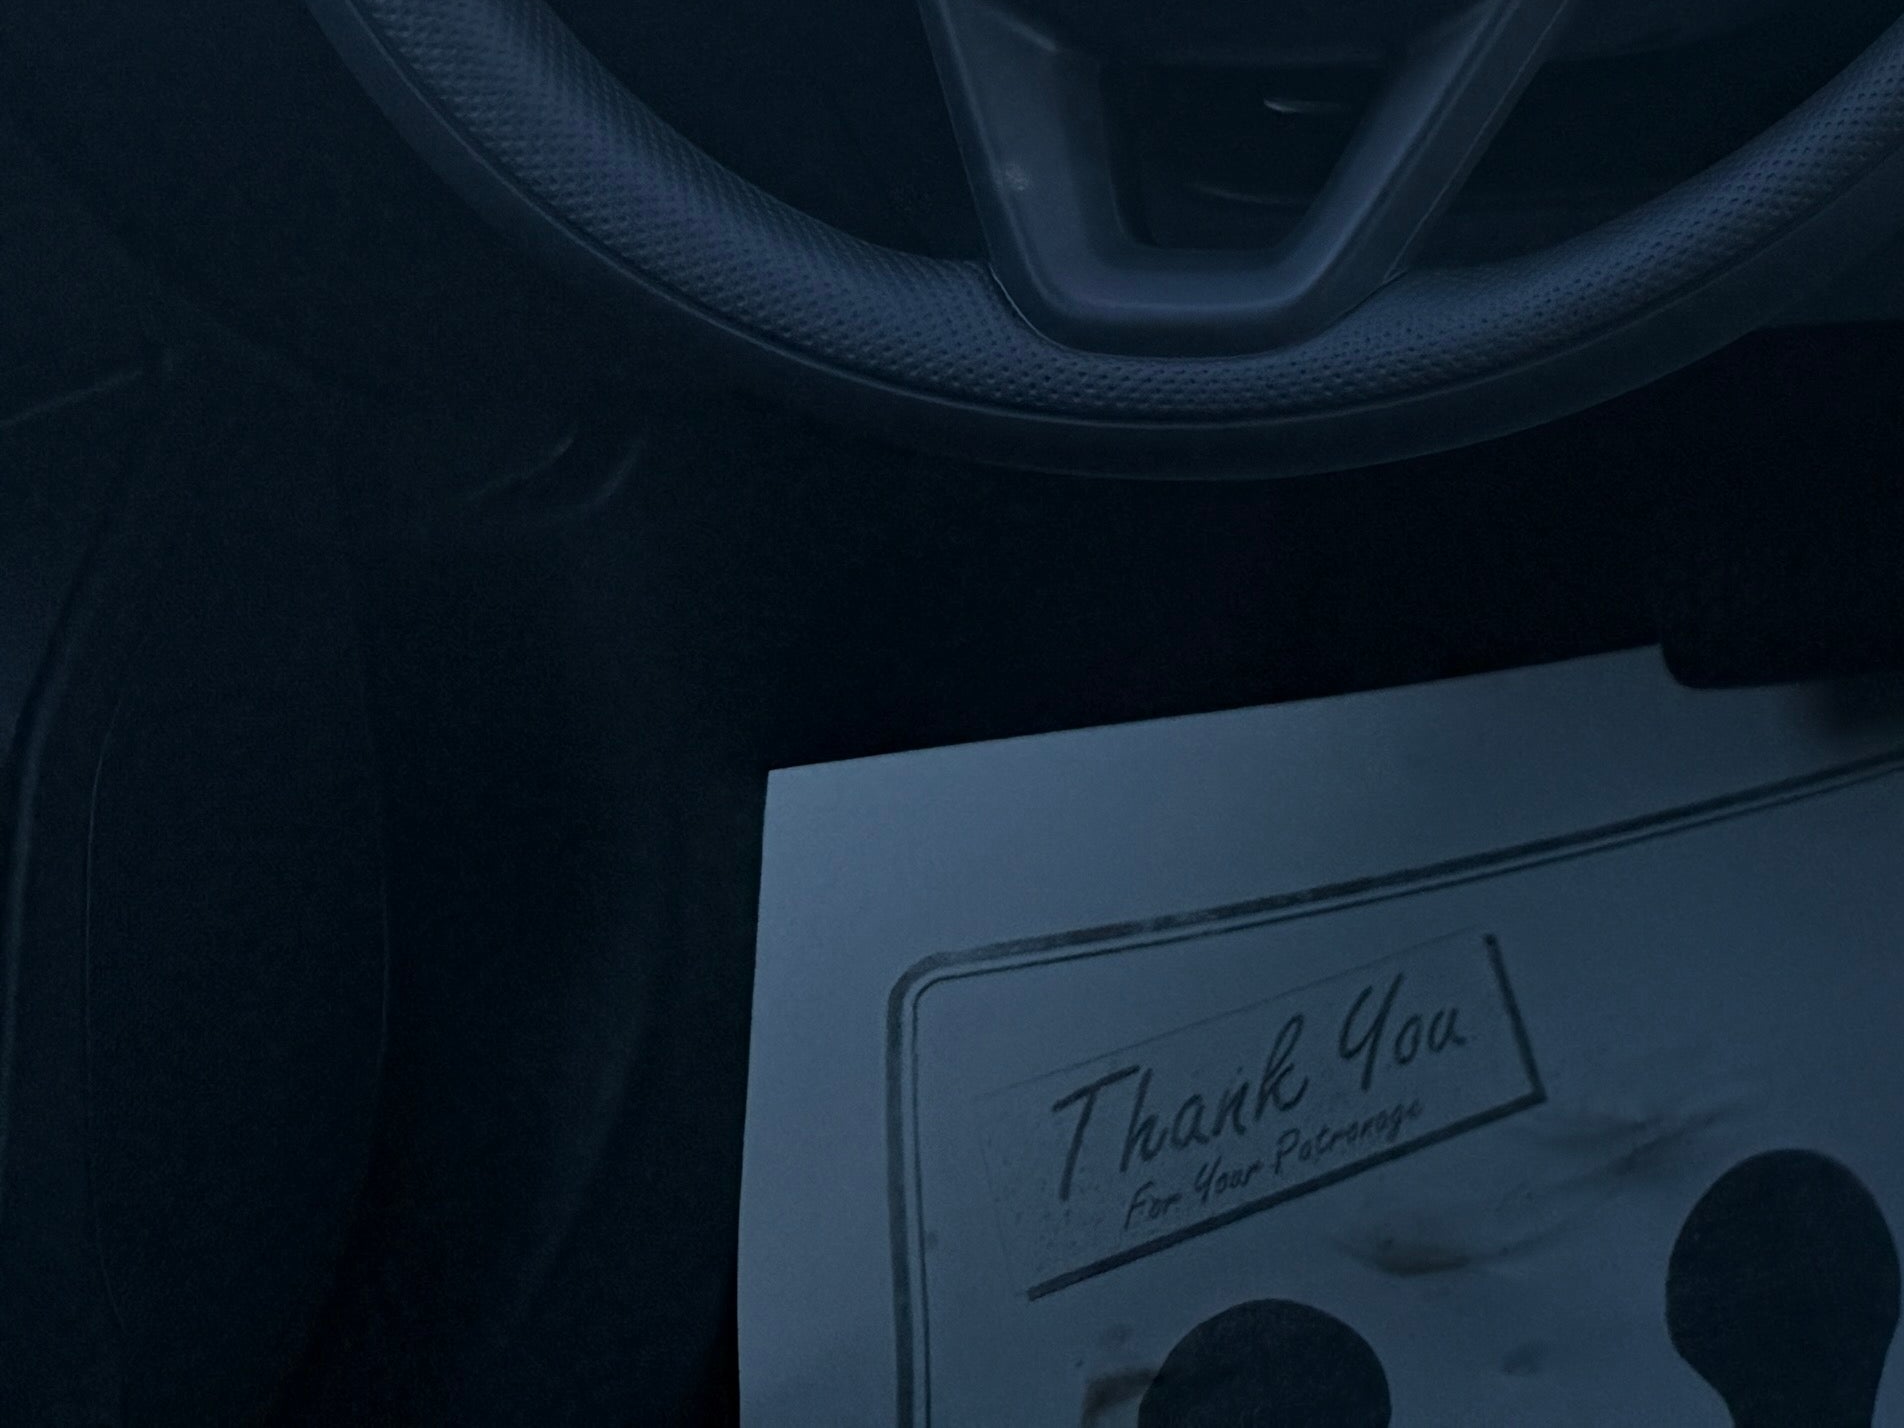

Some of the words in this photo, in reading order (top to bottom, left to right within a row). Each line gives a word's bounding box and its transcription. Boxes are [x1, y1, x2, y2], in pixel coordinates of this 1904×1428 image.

[1052, 1012, 1311, 1202] Thank
[1337, 972, 1468, 1092] You
[1122, 1179, 1180, 1230] For
[1193, 1160, 1260, 1200] Your
[1274, 1097, 1425, 1176] Patronage
